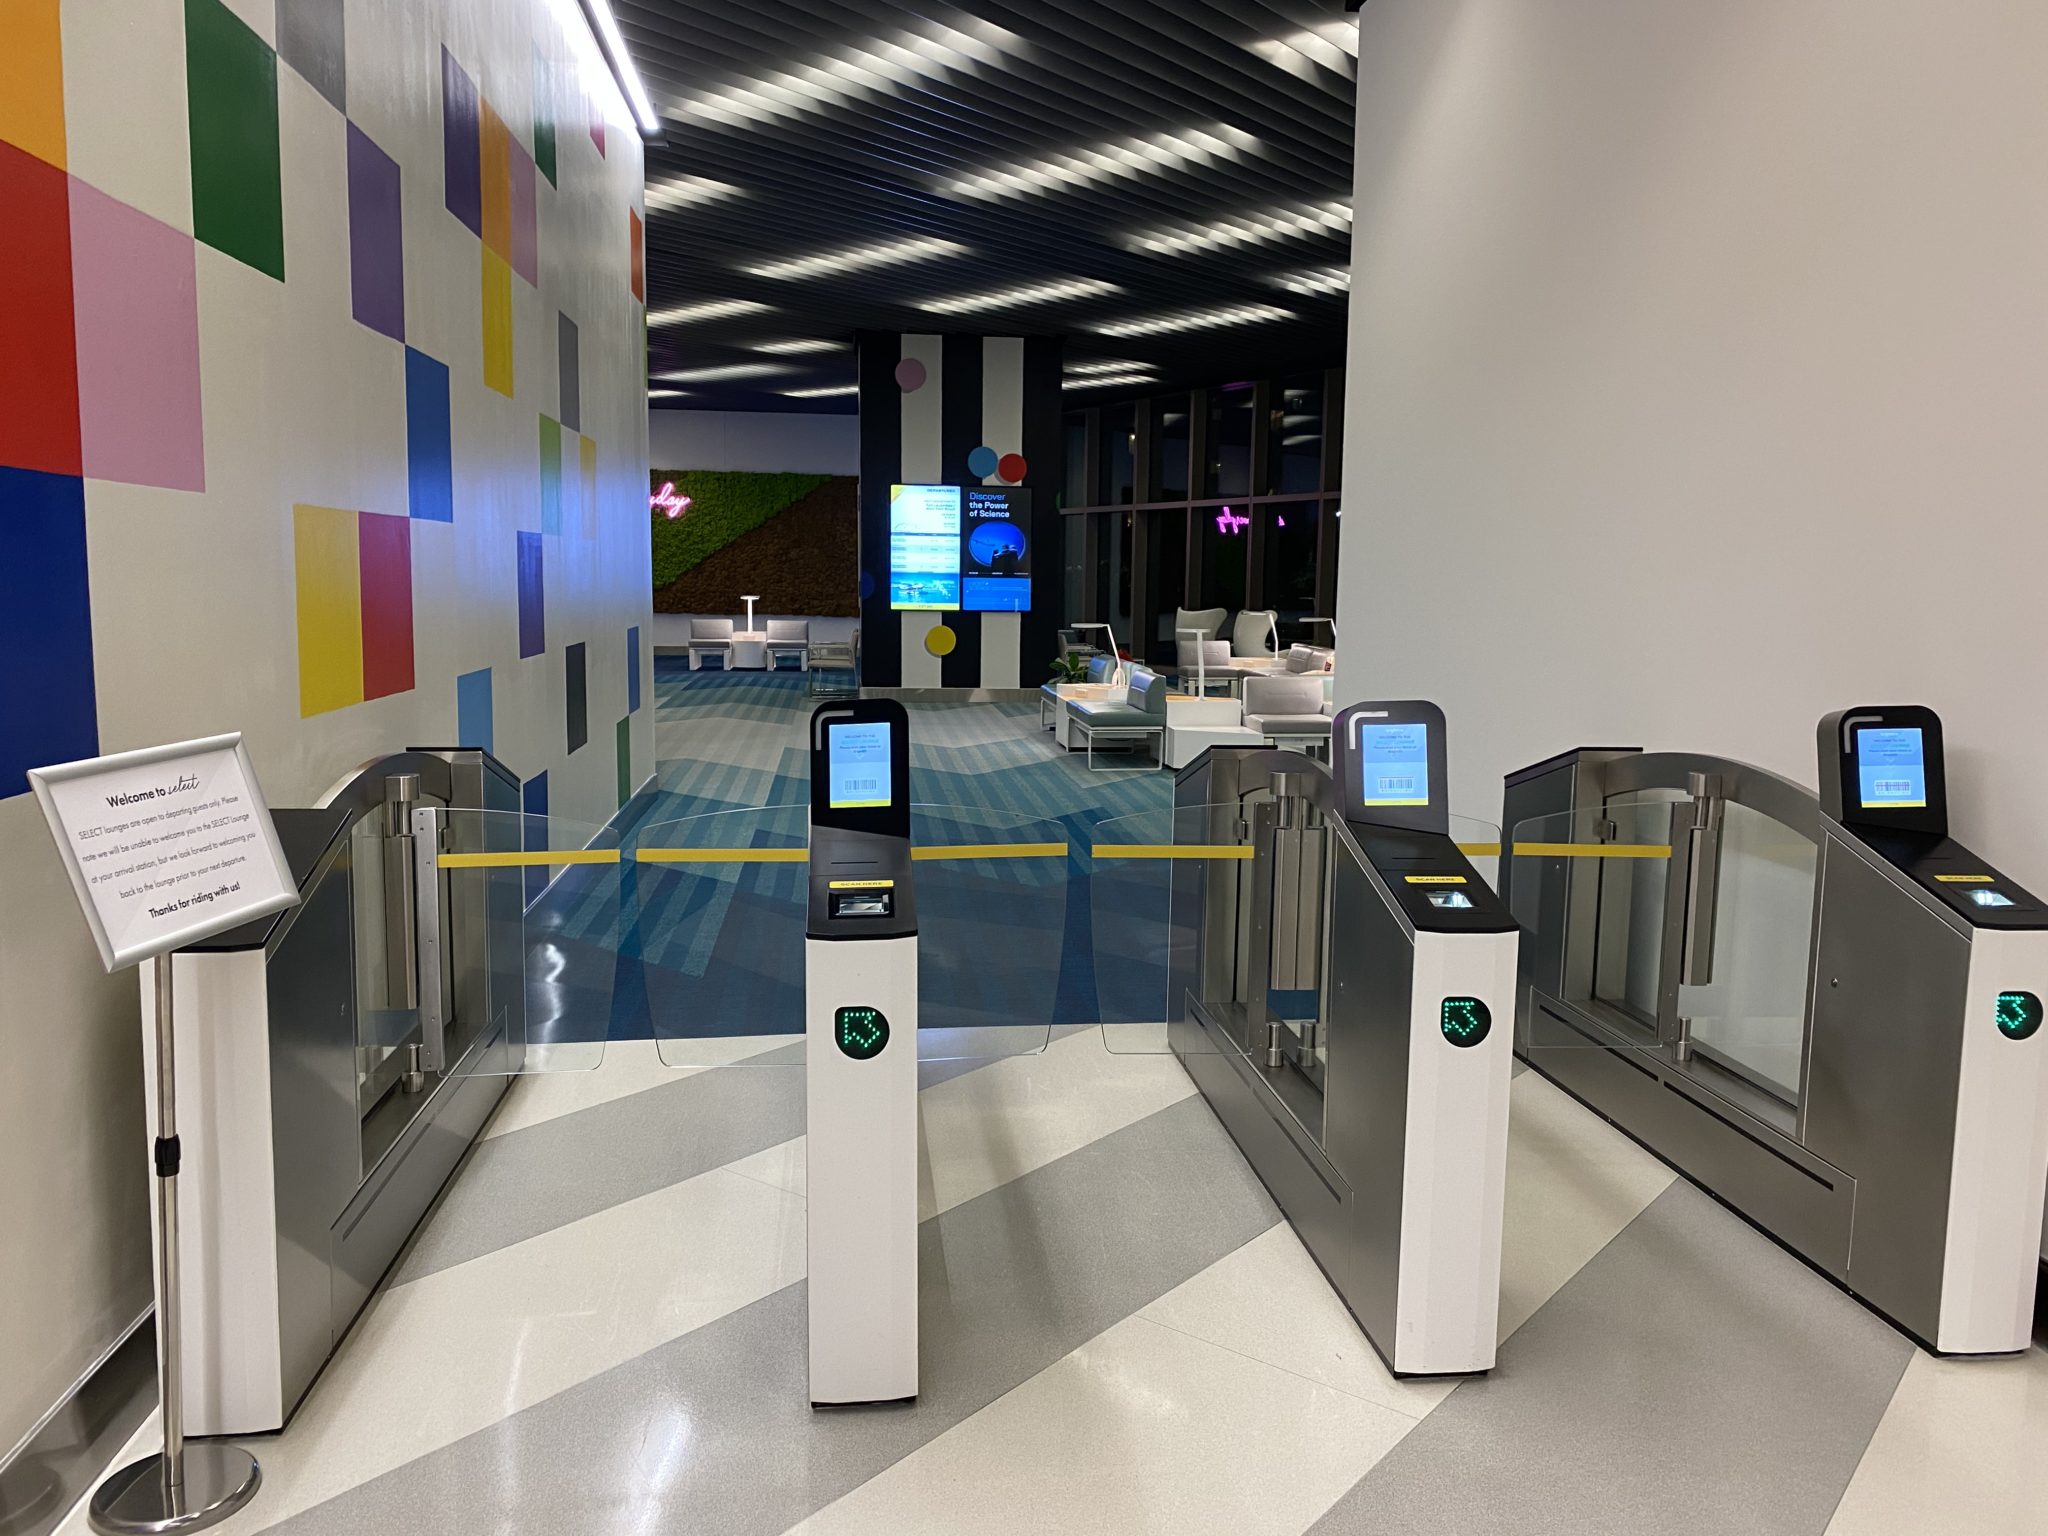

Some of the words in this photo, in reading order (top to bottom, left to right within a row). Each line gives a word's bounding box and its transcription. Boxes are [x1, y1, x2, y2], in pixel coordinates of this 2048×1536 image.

[969, 492, 1006, 500] Discover
[979, 510, 1010, 518] Science
[984, 501, 1009, 509] Power
[105, 791, 155, 808] Welcome
[155, 787, 166, 797] to
[167, 773, 200, 795] select
[78, 826, 103, 841] SELECT
[103, 822, 130, 834] lounges
[129, 820, 141, 828] are
[141, 815, 158, 826] open
[165, 807, 192, 819] departing
[192, 803, 209, 815] guests
[209, 799, 221, 809] only.
[221, 796, 239, 805] Please
[82, 854, 97, 862] note
[108, 845, 120, 855] will
[120, 844, 130, 853] be
[130, 837, 152, 850] unable
[152, 836, 160, 844] to
[160, 831, 186, 842] welcome
[186, 828, 197, 838] you
[202, 822, 212, 830] the
[210, 816, 231, 829] SELECT
[91, 875, 99, 884] at
[99, 873, 113, 885] your
[114, 864, 136, 878] arrival
[135, 861, 158, 871] station,
[157, 856, 169, 865] but
[178, 848, 191, 859] look
[190, 843, 213, 855] forward
[219, 834, 246, 846] welcoming
[245, 832, 256, 842] you
[119, 887, 137, 899] back
[136, 886, 144, 894] to
[143, 882, 155, 891] the
[153, 877, 176, 888] lounge
[175, 872, 190, 884] prior
[190, 870, 198, 878] to
[197, 867, 209, 878] your
[209, 863, 221, 872] next
[221, 855, 247, 868] departure.
[148, 902, 179, 919] Thanks
[177, 899, 191, 909] for
[190, 892, 214, 903] riding
[213, 884, 230, 897] with
[230, 881, 241, 893] us!
